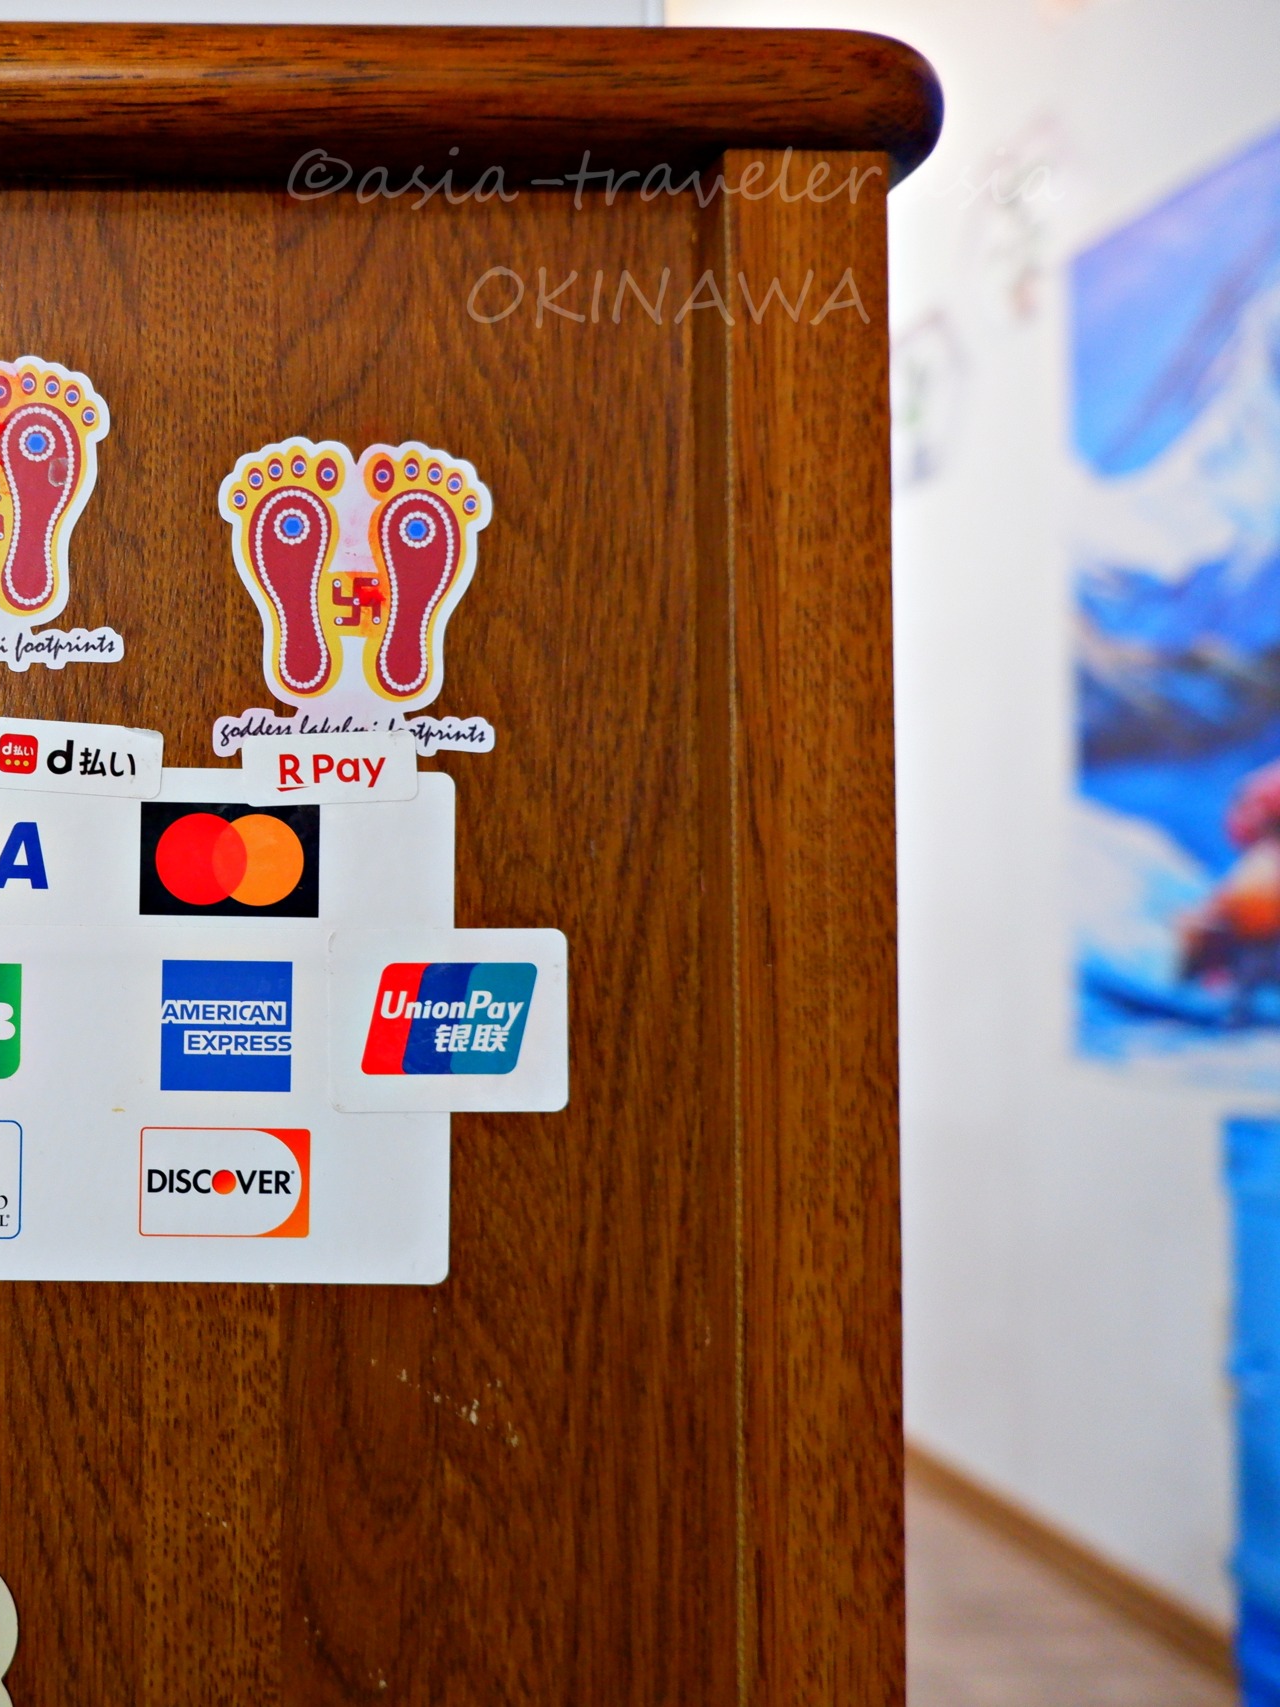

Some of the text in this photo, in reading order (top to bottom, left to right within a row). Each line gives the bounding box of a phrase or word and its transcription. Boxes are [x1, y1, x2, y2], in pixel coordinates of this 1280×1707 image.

[14, 632, 116, 662] footprints
[220, 715, 293, 747] goddess
[46, 739, 136, 778] d払い
[312, 753, 387, 788] Pay
[161, 1001, 283, 1024] AMERICAN
[379, 990, 525, 1031] UnionPay
[186, 1034, 292, 1053] EXPRESS
[433, 1023, 509, 1053] 银联
[147, 1168, 292, 1195] DISCOVER
